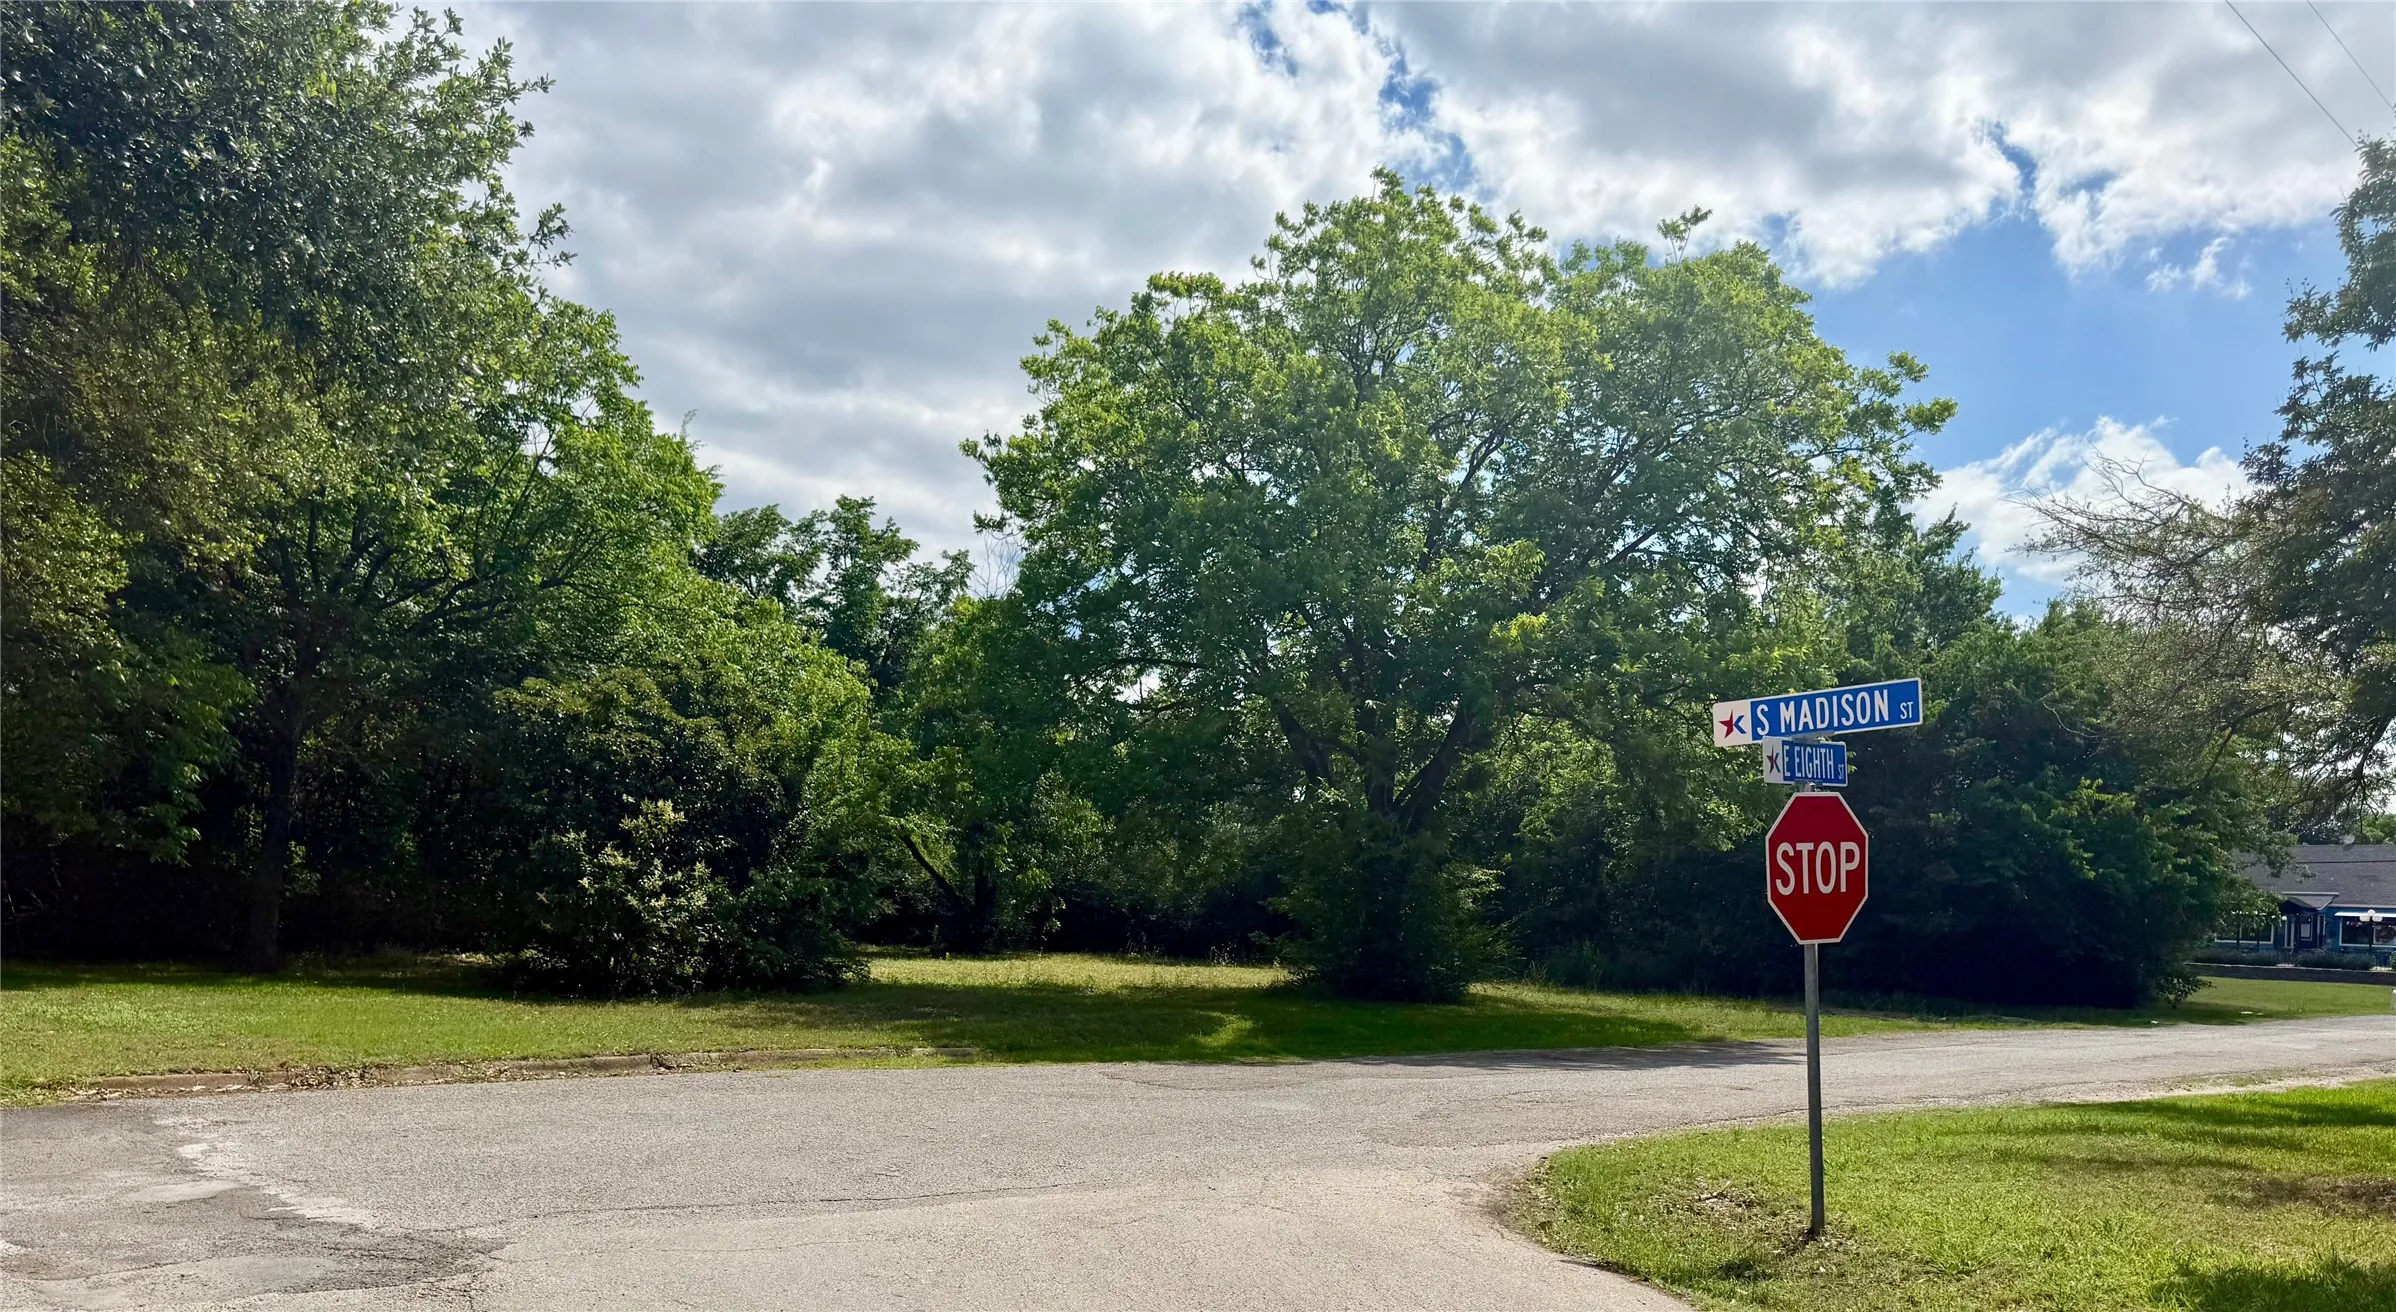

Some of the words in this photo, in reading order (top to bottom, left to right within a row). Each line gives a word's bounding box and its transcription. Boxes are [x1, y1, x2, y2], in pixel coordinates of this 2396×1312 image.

[1756, 704, 1770, 736] S
[1780, 689, 1889, 733] MADISON
[1900, 701, 1914, 720] ST
[1783, 745, 1791, 777] E
[1794, 746, 1835, 779] EIGHTH
[1837, 763, 1845, 780] ST
[1775, 841, 1861, 896] STOP
